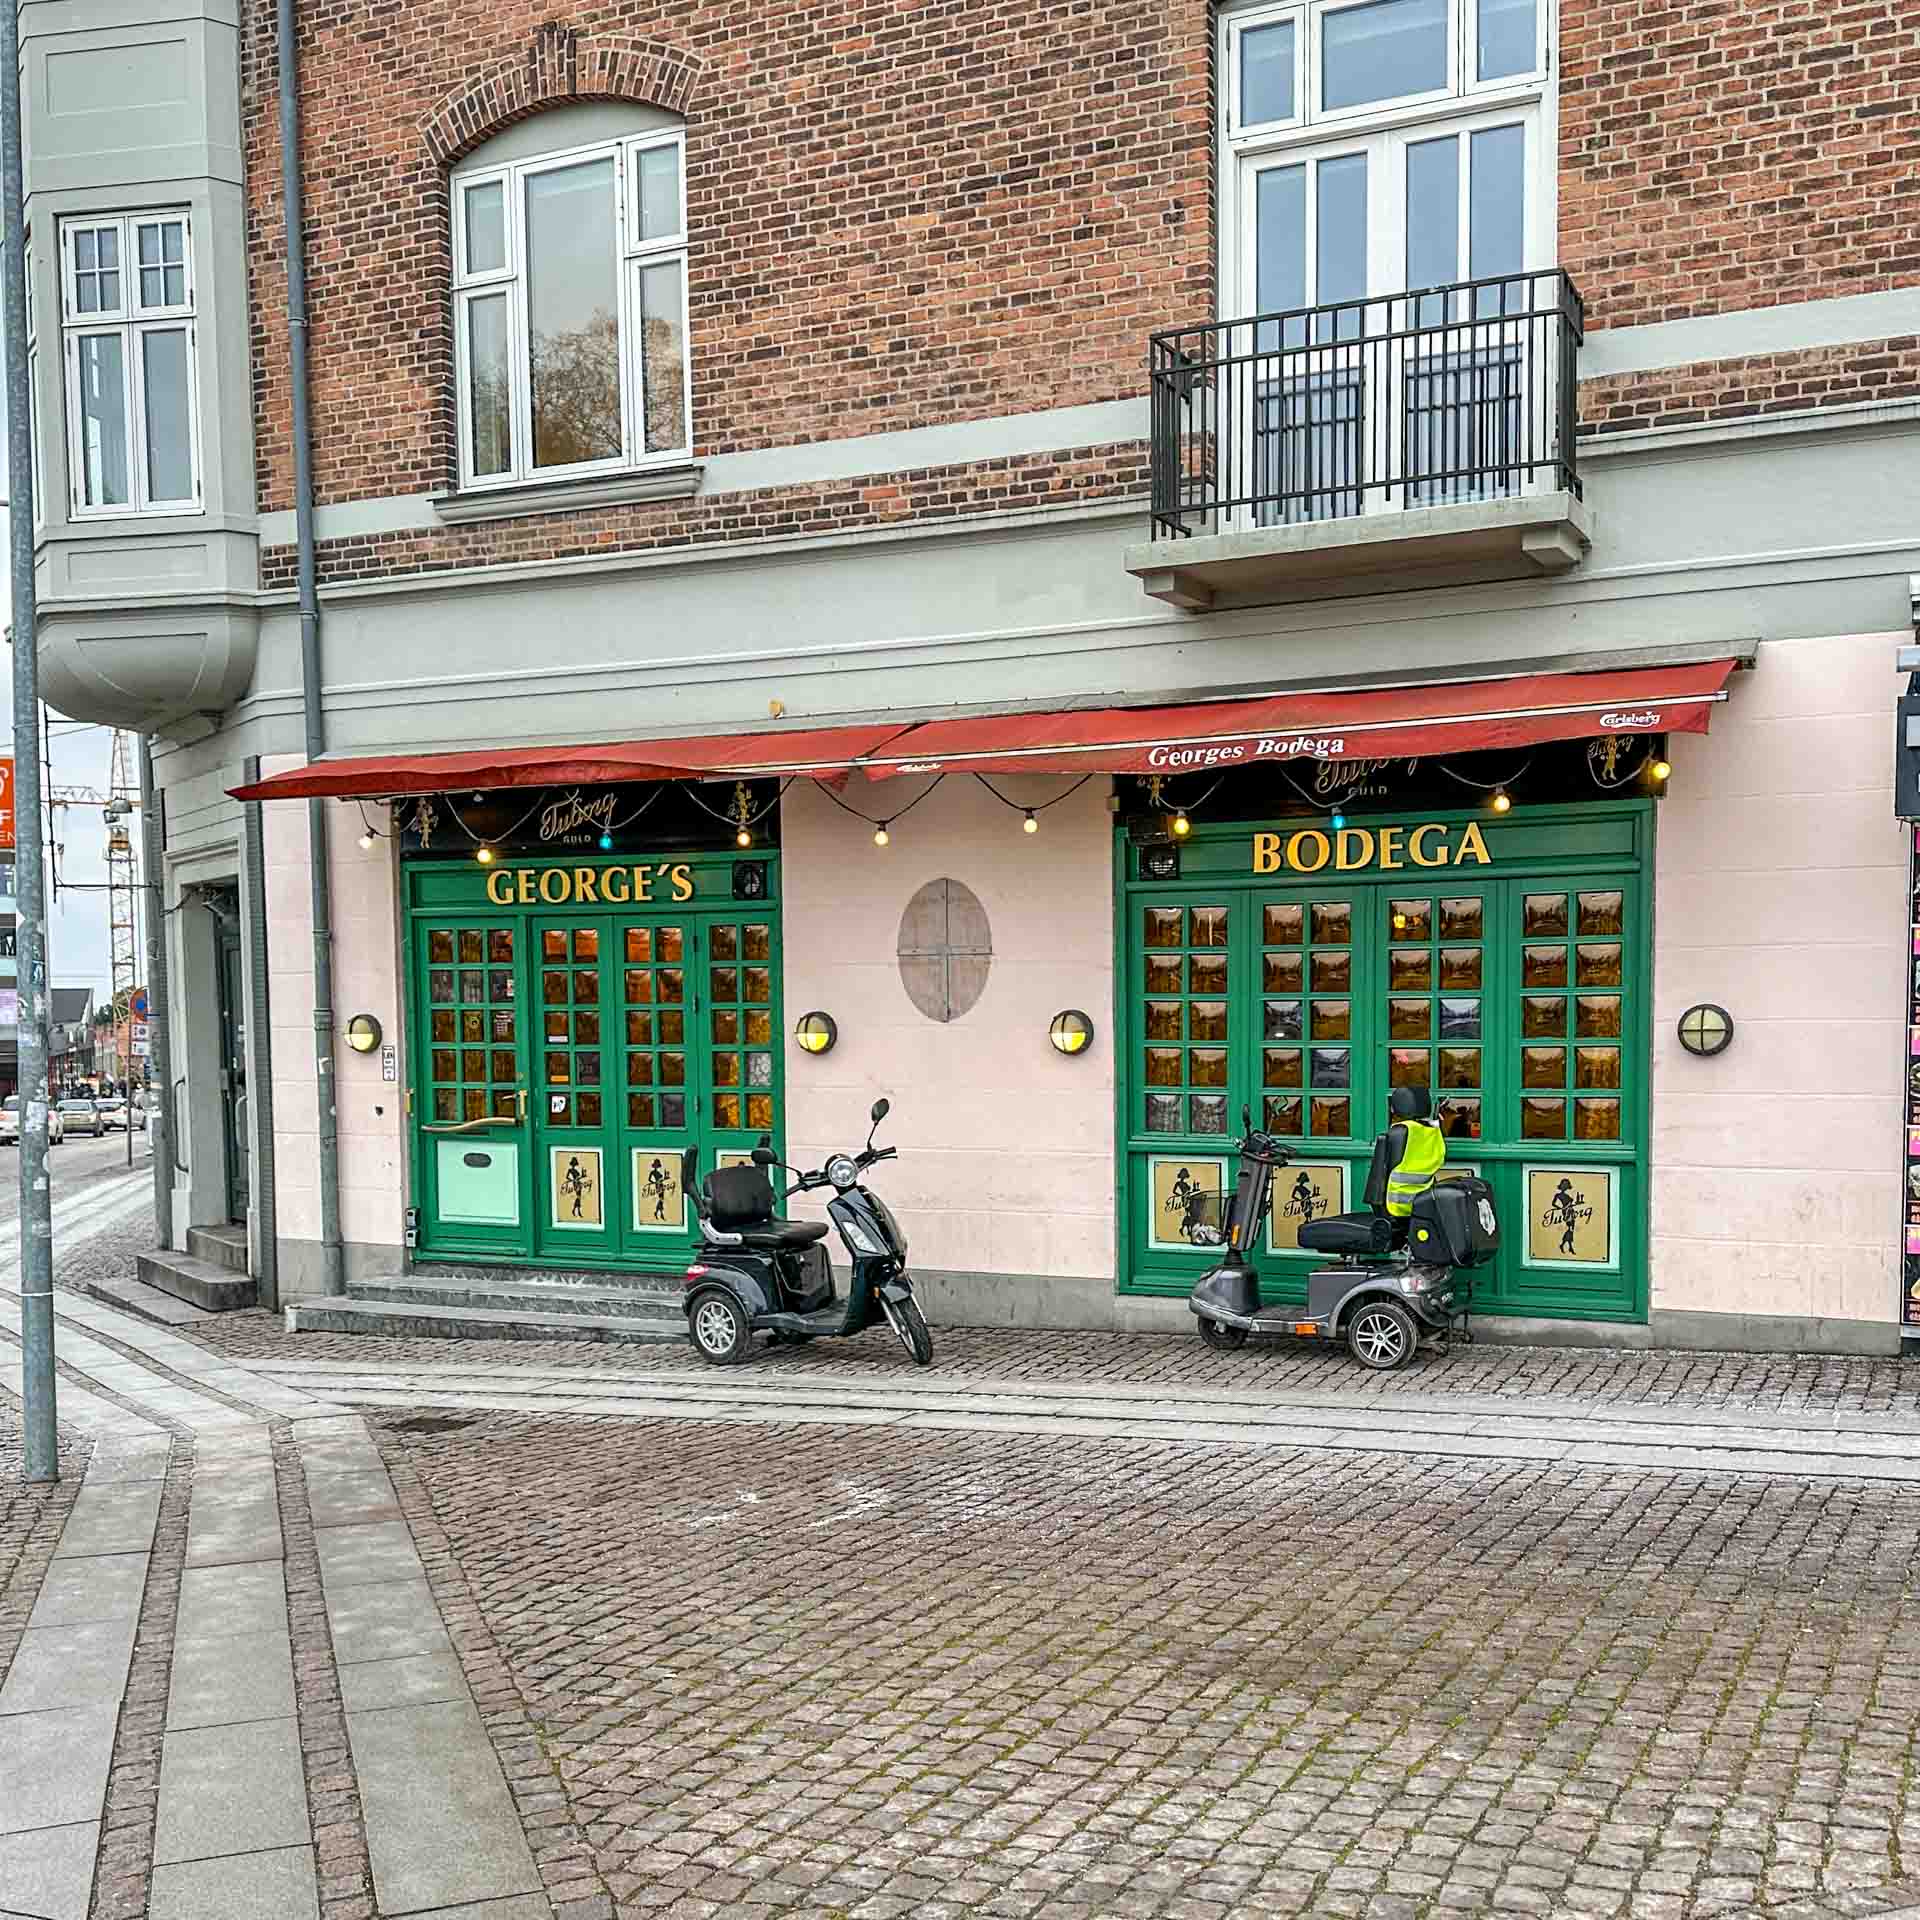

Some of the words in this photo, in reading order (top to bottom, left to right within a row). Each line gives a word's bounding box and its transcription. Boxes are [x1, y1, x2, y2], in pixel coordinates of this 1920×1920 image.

[1600, 711, 1661, 728] Carlsberg
[1149, 745, 1244, 766] Georges
[1256, 736, 1344, 756] Bodega
[1253, 822, 1492, 873] BODEGA
[487, 864, 694, 905] GEORGE'S
